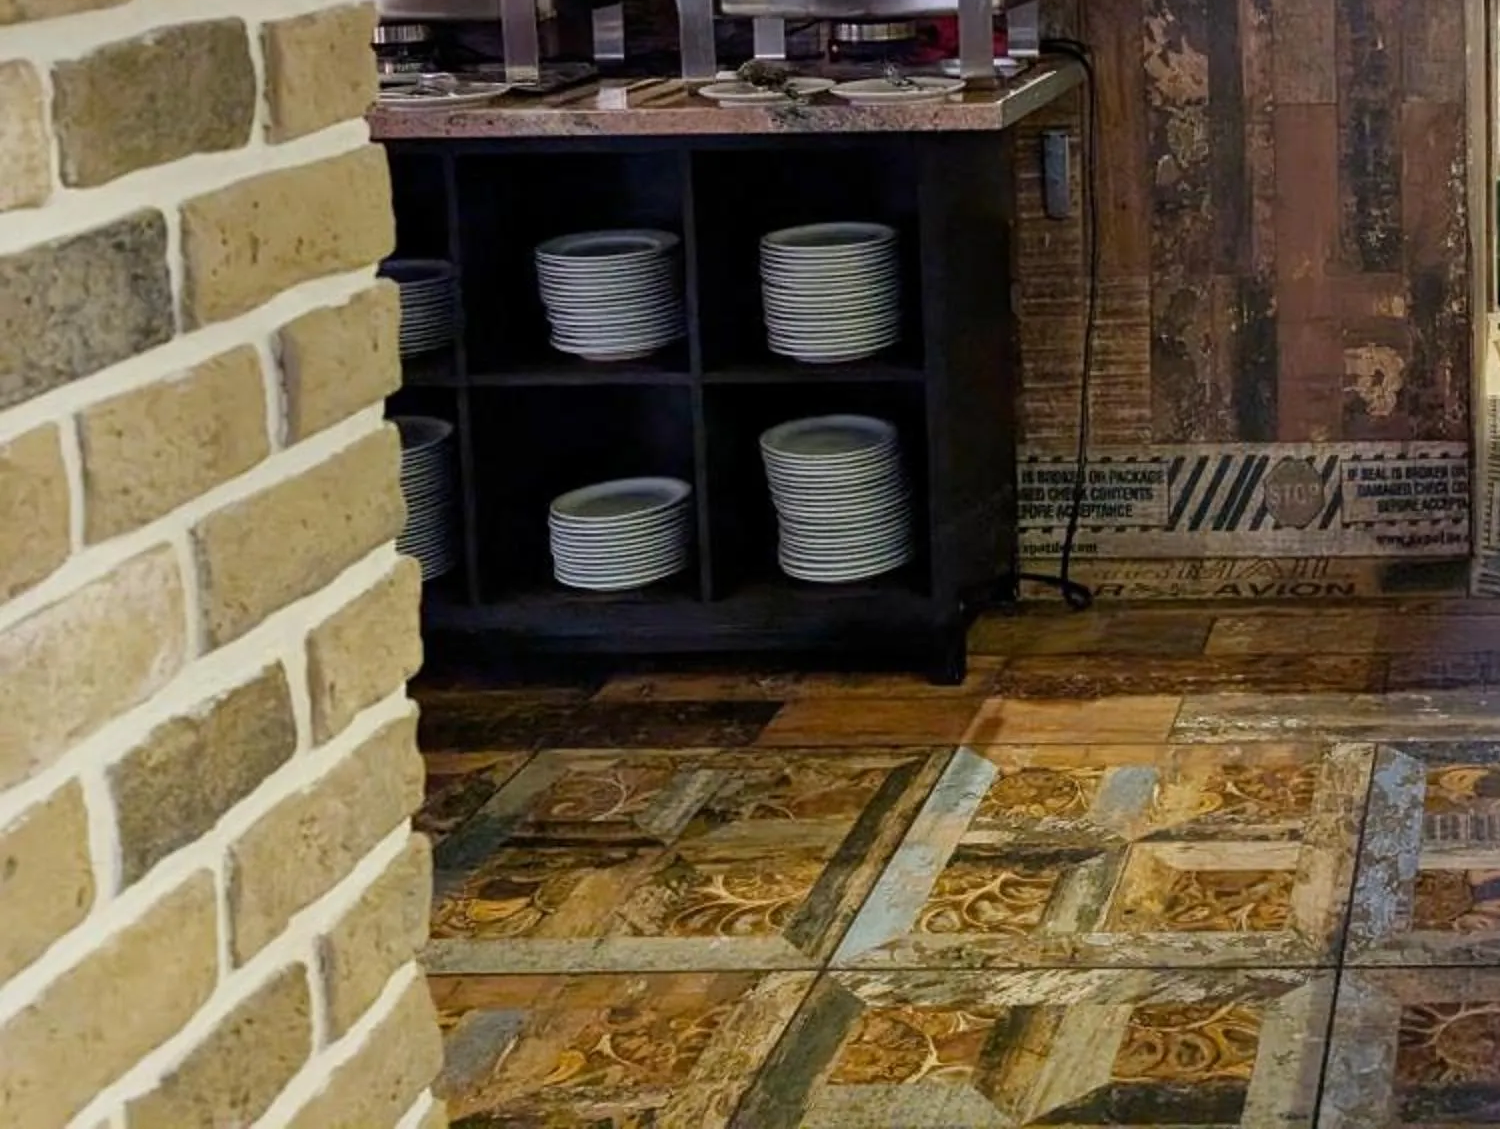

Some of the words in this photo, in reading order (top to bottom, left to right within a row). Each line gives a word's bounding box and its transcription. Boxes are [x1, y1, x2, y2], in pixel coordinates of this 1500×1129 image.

[1109, 469, 1165, 484] PACKAGE
[1362, 468, 1388, 480] SEAL
[1405, 466, 1449, 479] BROKEN
[1090, 487, 1154, 501] CONTENTS
[1265, 482, 1320, 507] STOP
[1357, 483, 1412, 496] DAMAGED
[1415, 482, 1449, 495] CHECK
[1214, 582, 1357, 596] AVION
